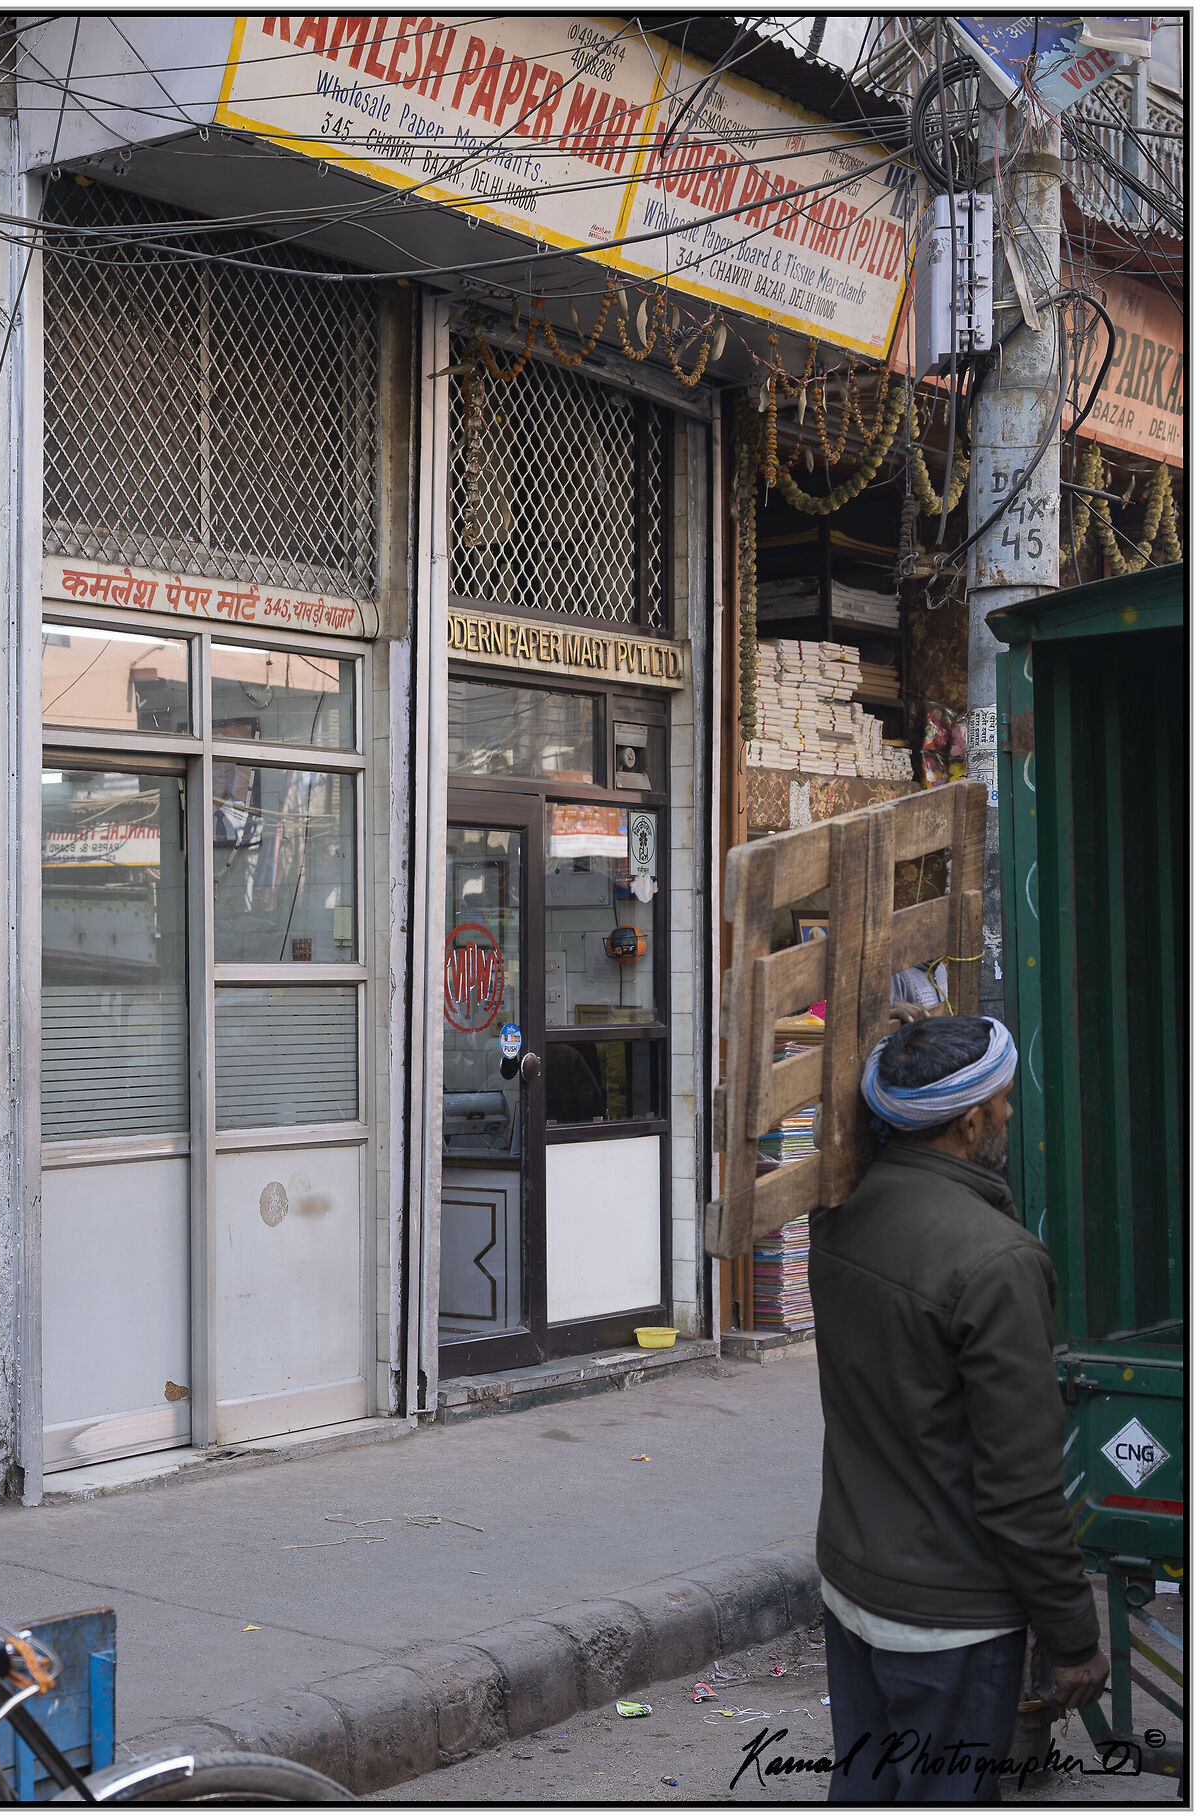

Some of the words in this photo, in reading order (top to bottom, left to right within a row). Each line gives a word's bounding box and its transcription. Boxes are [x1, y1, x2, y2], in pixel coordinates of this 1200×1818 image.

[1060, 49, 1116, 90] VOTE
[317, 69, 391, 122] Wholesale
[400, 103, 445, 142] Paper
[451, 35, 564, 145] PAPER
[559, 81, 642, 174] MART
[366, 128, 415, 167] CHAWRI
[642, 121, 744, 213] MODERN
[734, 160, 806, 241] PAPER
[799, 187, 858, 262] MART
[643, 198, 699, 243] Wholesale
[736, 238, 770, 269] Board
[769, 250, 781, 273] &
[783, 253, 816, 285] Tissue
[817, 266, 868, 305] Merchants
[710, 259, 752, 289] CHAWRI
[754, 274, 786, 307] BAZAR,
[1098, 326, 1183, 416] PARKA
[1001, 526, 1043, 560] 45
[62, 567, 159, 609] कमलेश
[165, 576, 213, 617] पेपर
[216, 584, 261, 621] मार्ट
[448, 616, 503, 654] DERN
[504, 623, 561, 663] PAPER
[563, 633, 611, 669] MART
[1115, 1433, 1154, 1463] CNG
